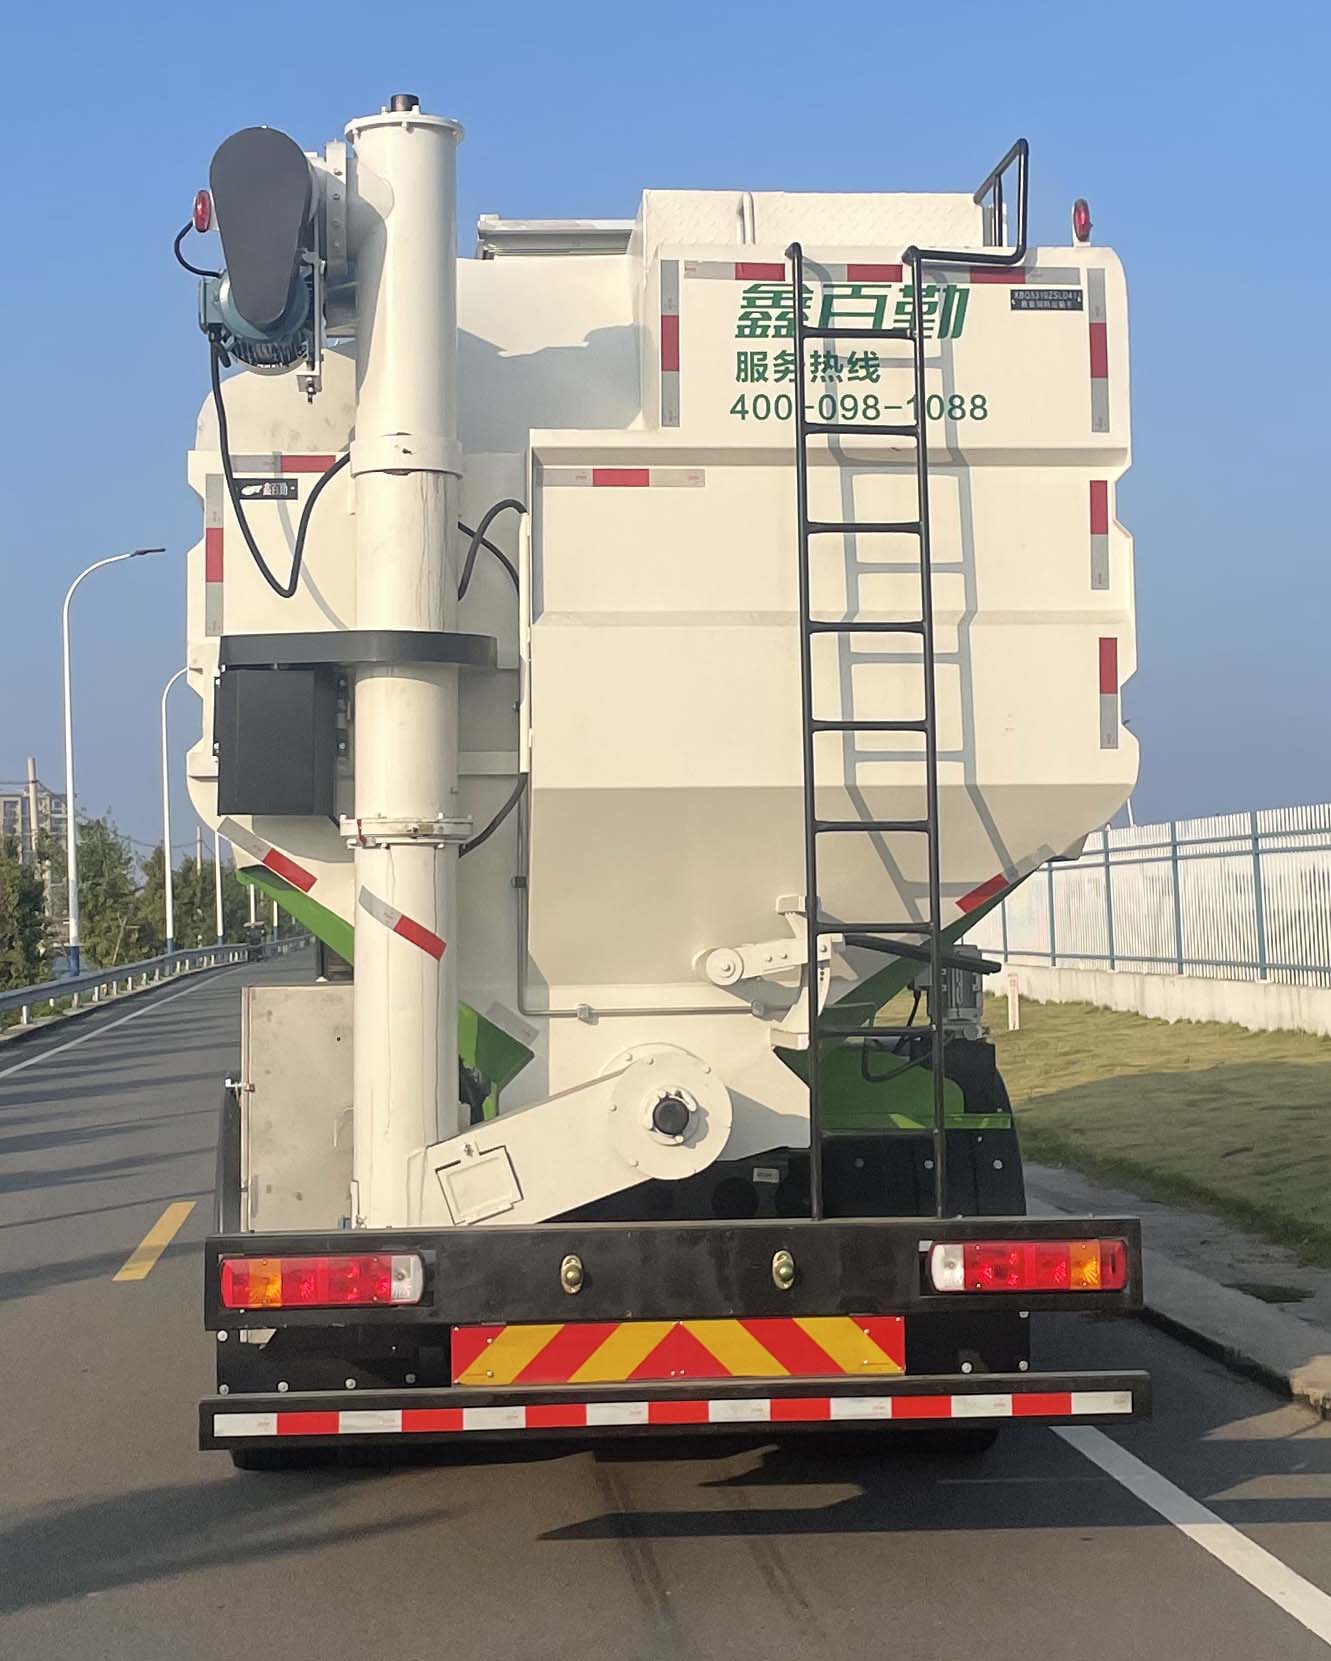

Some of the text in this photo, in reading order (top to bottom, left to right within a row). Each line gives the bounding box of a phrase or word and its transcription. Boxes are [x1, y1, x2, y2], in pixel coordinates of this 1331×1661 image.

[735, 283, 970, 339] 鑫百勤
[735, 349, 881, 383] 服务热线
[729, 393, 988, 421] 400-098-1088
